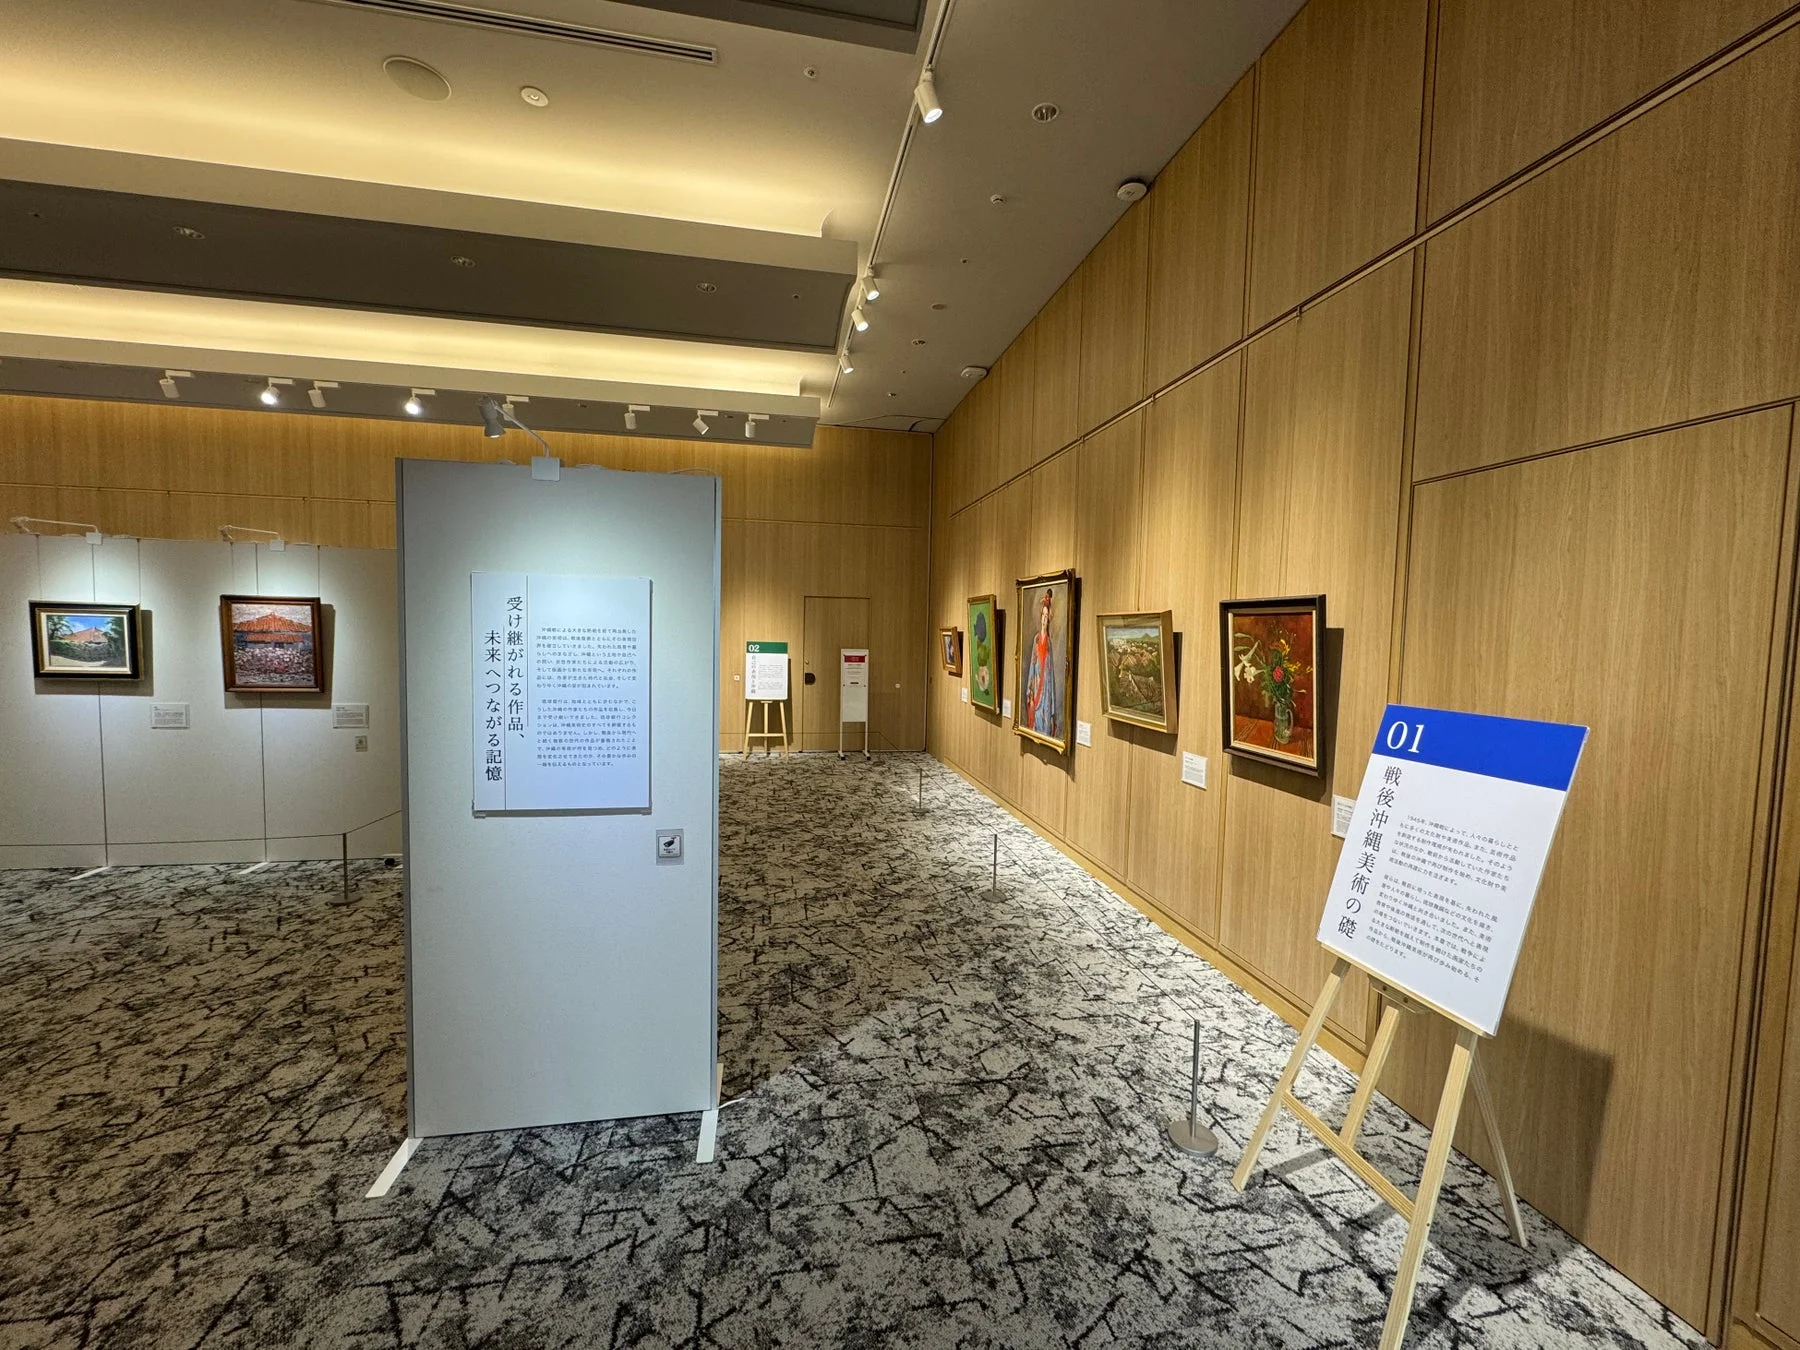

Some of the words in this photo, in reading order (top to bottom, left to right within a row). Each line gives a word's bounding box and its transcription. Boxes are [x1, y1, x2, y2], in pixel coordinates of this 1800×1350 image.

[484, 629, 502, 781] 未来へつながる記憶
[507, 596, 525, 739] 受け継がれる作品、
[748, 644, 760, 652] 02
[1386, 720, 1425, 754] 01
[1337, 765, 1403, 940] 戦後沖縄美術の礎
